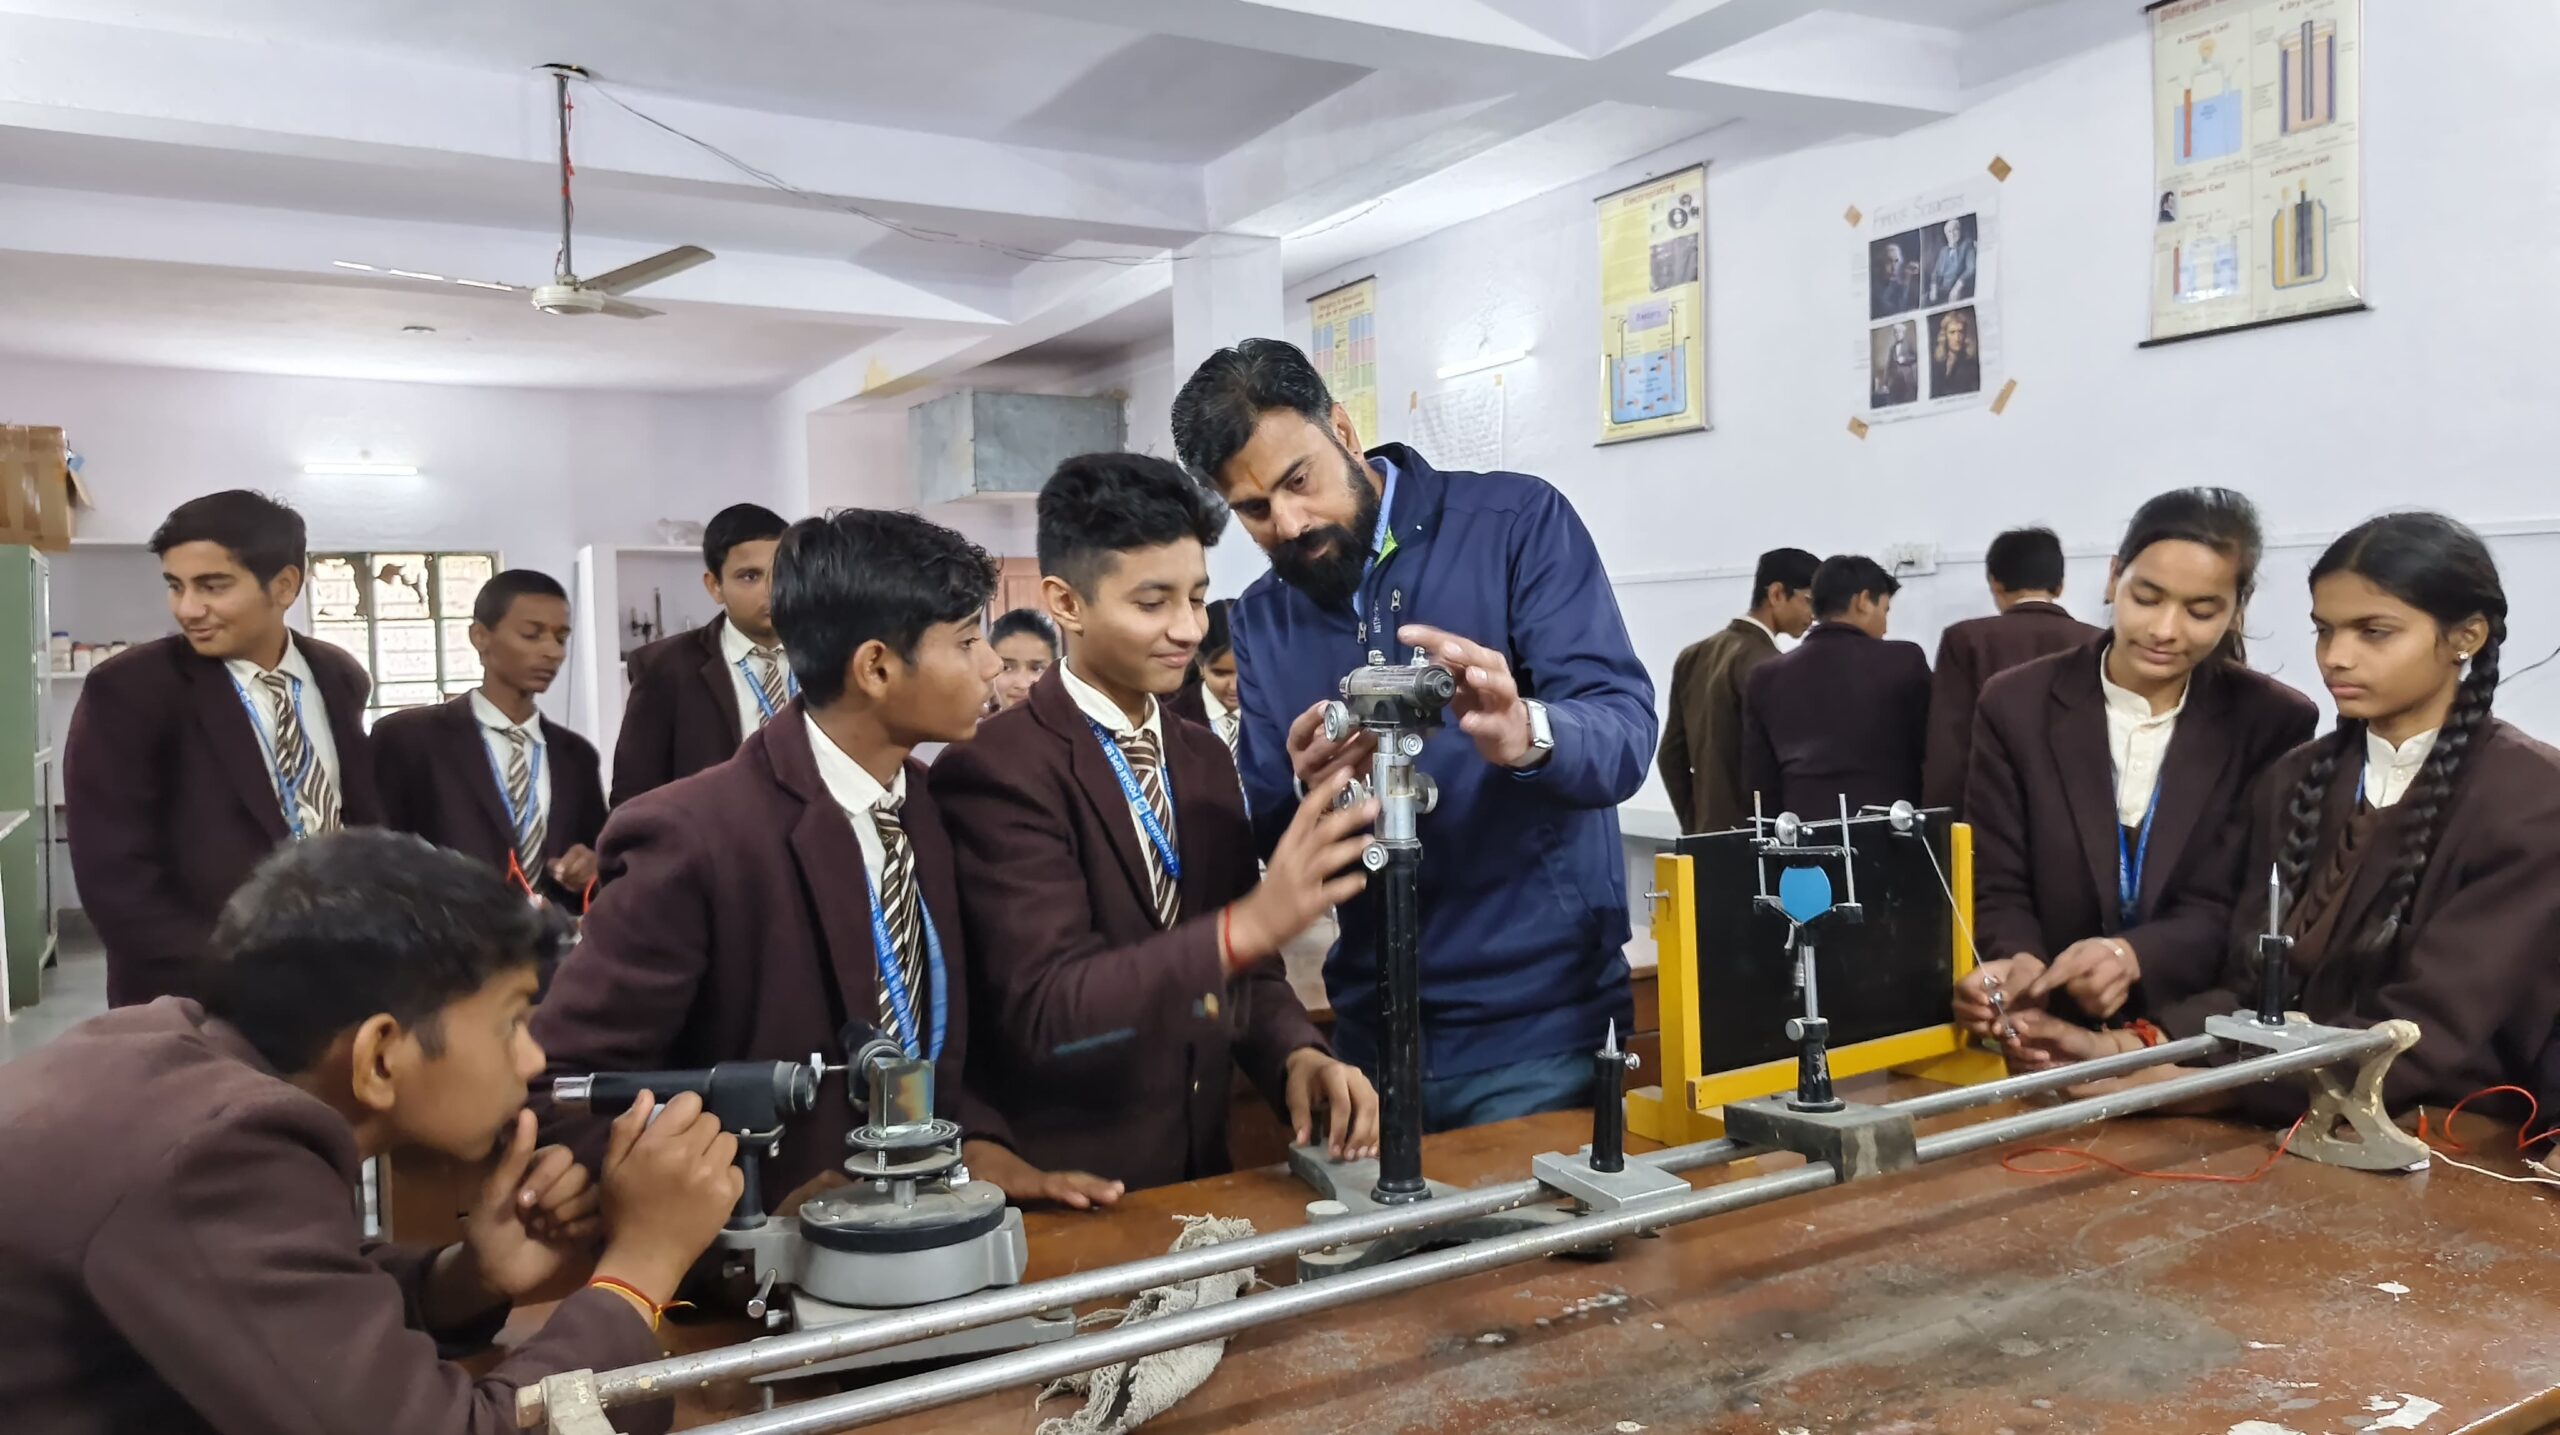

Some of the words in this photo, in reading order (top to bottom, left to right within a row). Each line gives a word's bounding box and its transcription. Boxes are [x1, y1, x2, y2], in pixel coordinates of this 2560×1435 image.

[1109, 754, 1124, 772] GPS
[1119, 769, 1141, 799] PODAR
[1143, 812, 1175, 865] NAWALGARH
